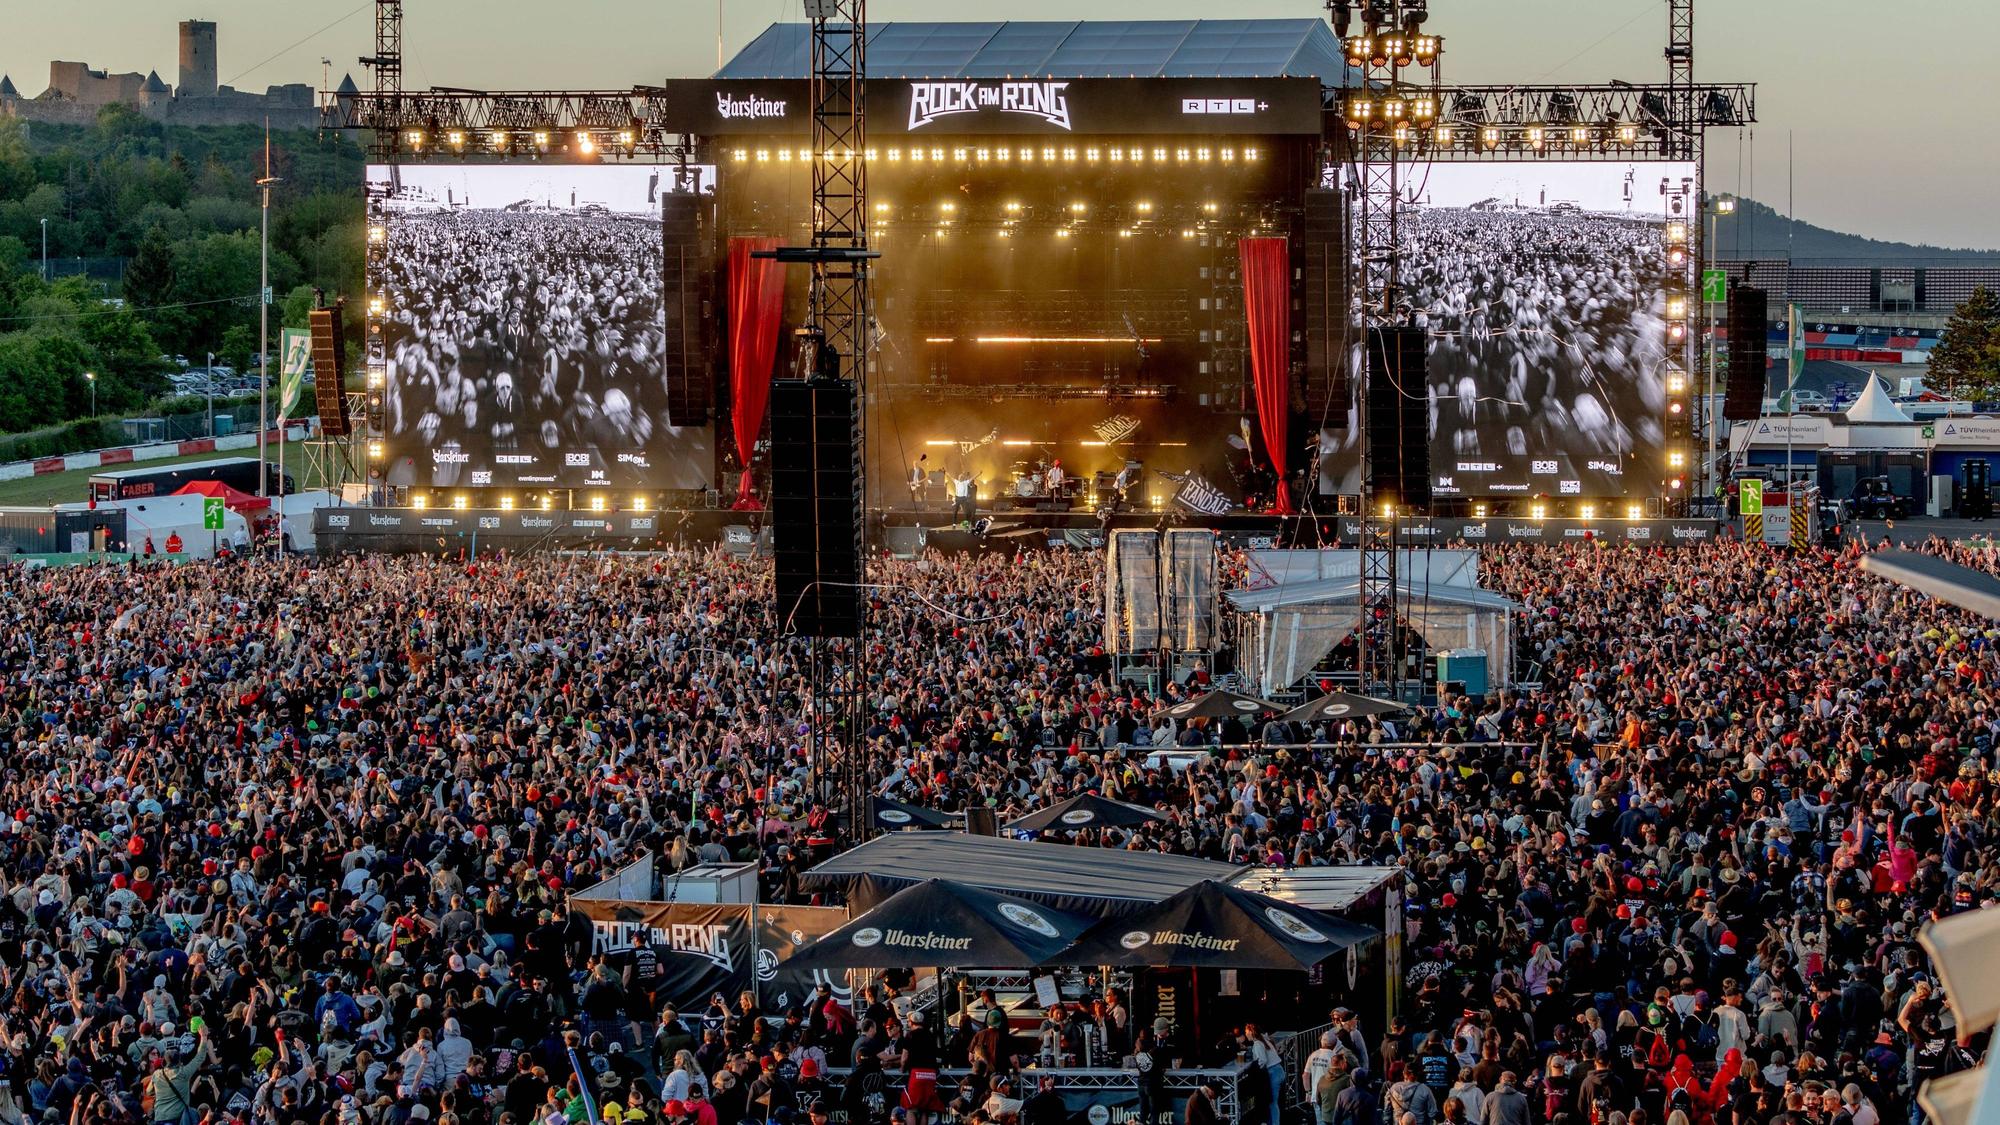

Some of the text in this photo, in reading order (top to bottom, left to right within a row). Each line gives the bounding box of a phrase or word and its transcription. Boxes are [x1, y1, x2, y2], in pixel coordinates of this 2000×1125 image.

[908, 83, 1072, 131] ROCK AM RING
[1773, 423, 1818, 433] TÜVheinland
[122, 483, 155, 496] FABER
[1181, 479, 1233, 515] RANDALE
[592, 920, 651, 955] ROCK
[651, 927, 670, 946] AM
[671, 923, 734, 973] RING
[884, 928, 973, 951] Warsteiner
[1152, 929, 1240, 952] Warsteiner
[1157, 985, 1176, 1025] einer
